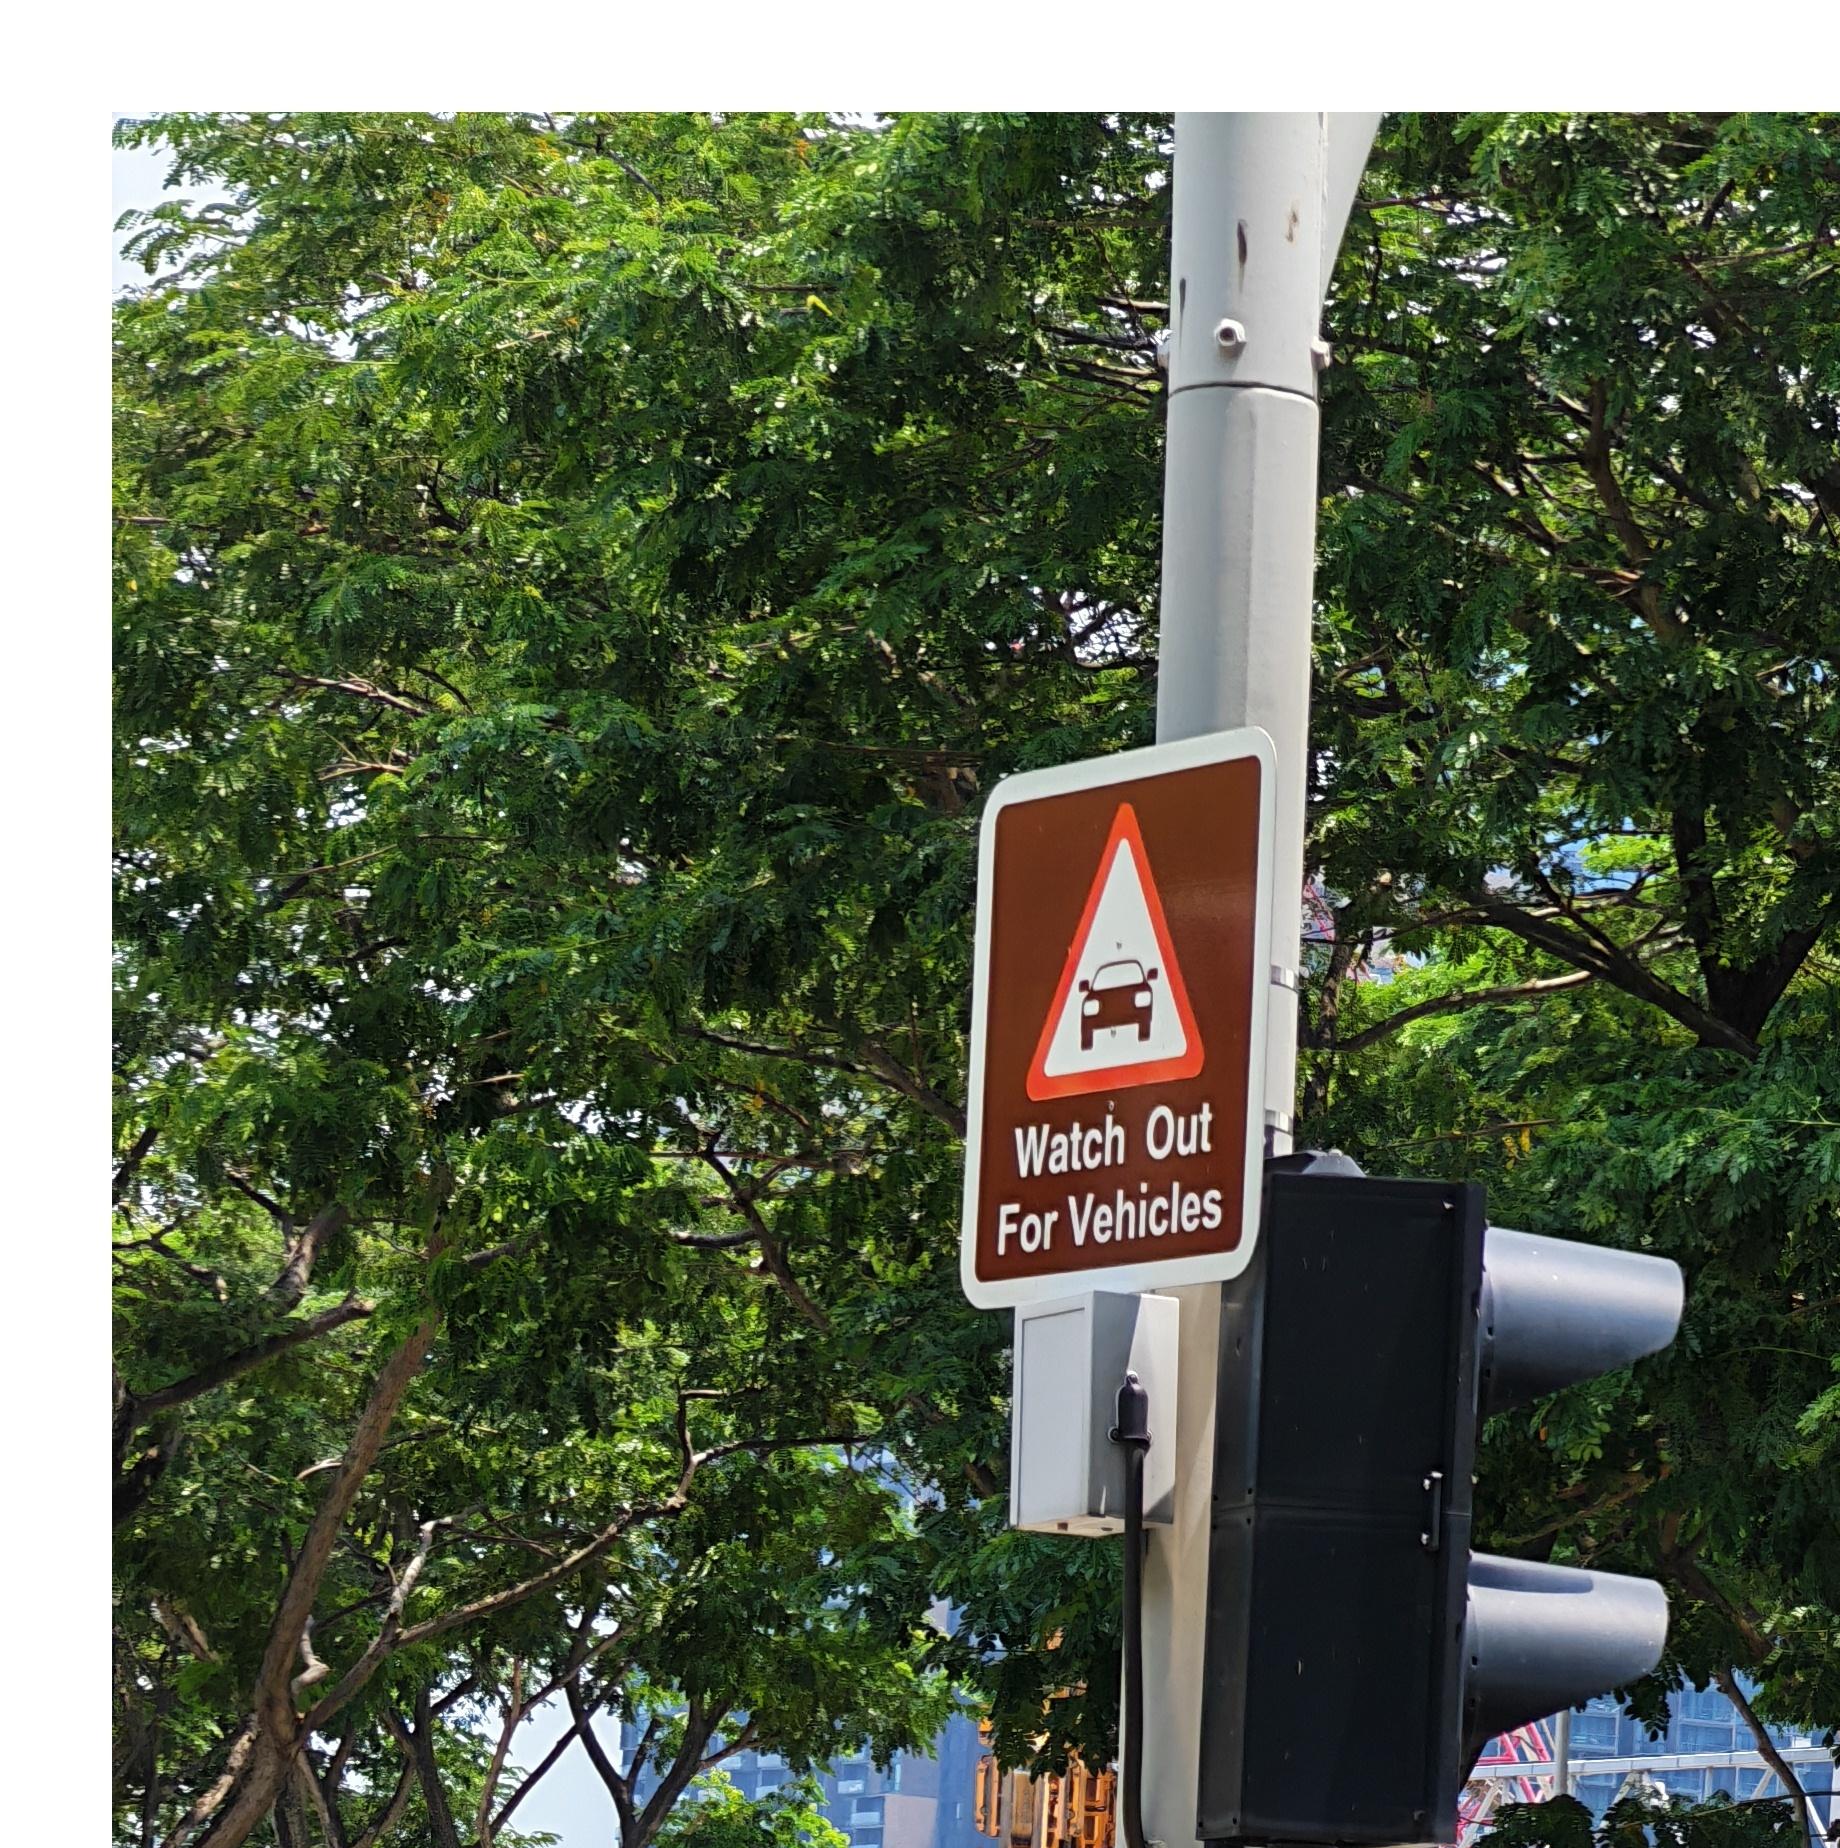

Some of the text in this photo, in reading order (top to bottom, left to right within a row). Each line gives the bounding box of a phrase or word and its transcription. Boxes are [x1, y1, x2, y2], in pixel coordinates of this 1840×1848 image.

[1015, 1102, 1212, 1179] Watch Out
[997, 1182, 1223, 1256] For Vehicles
